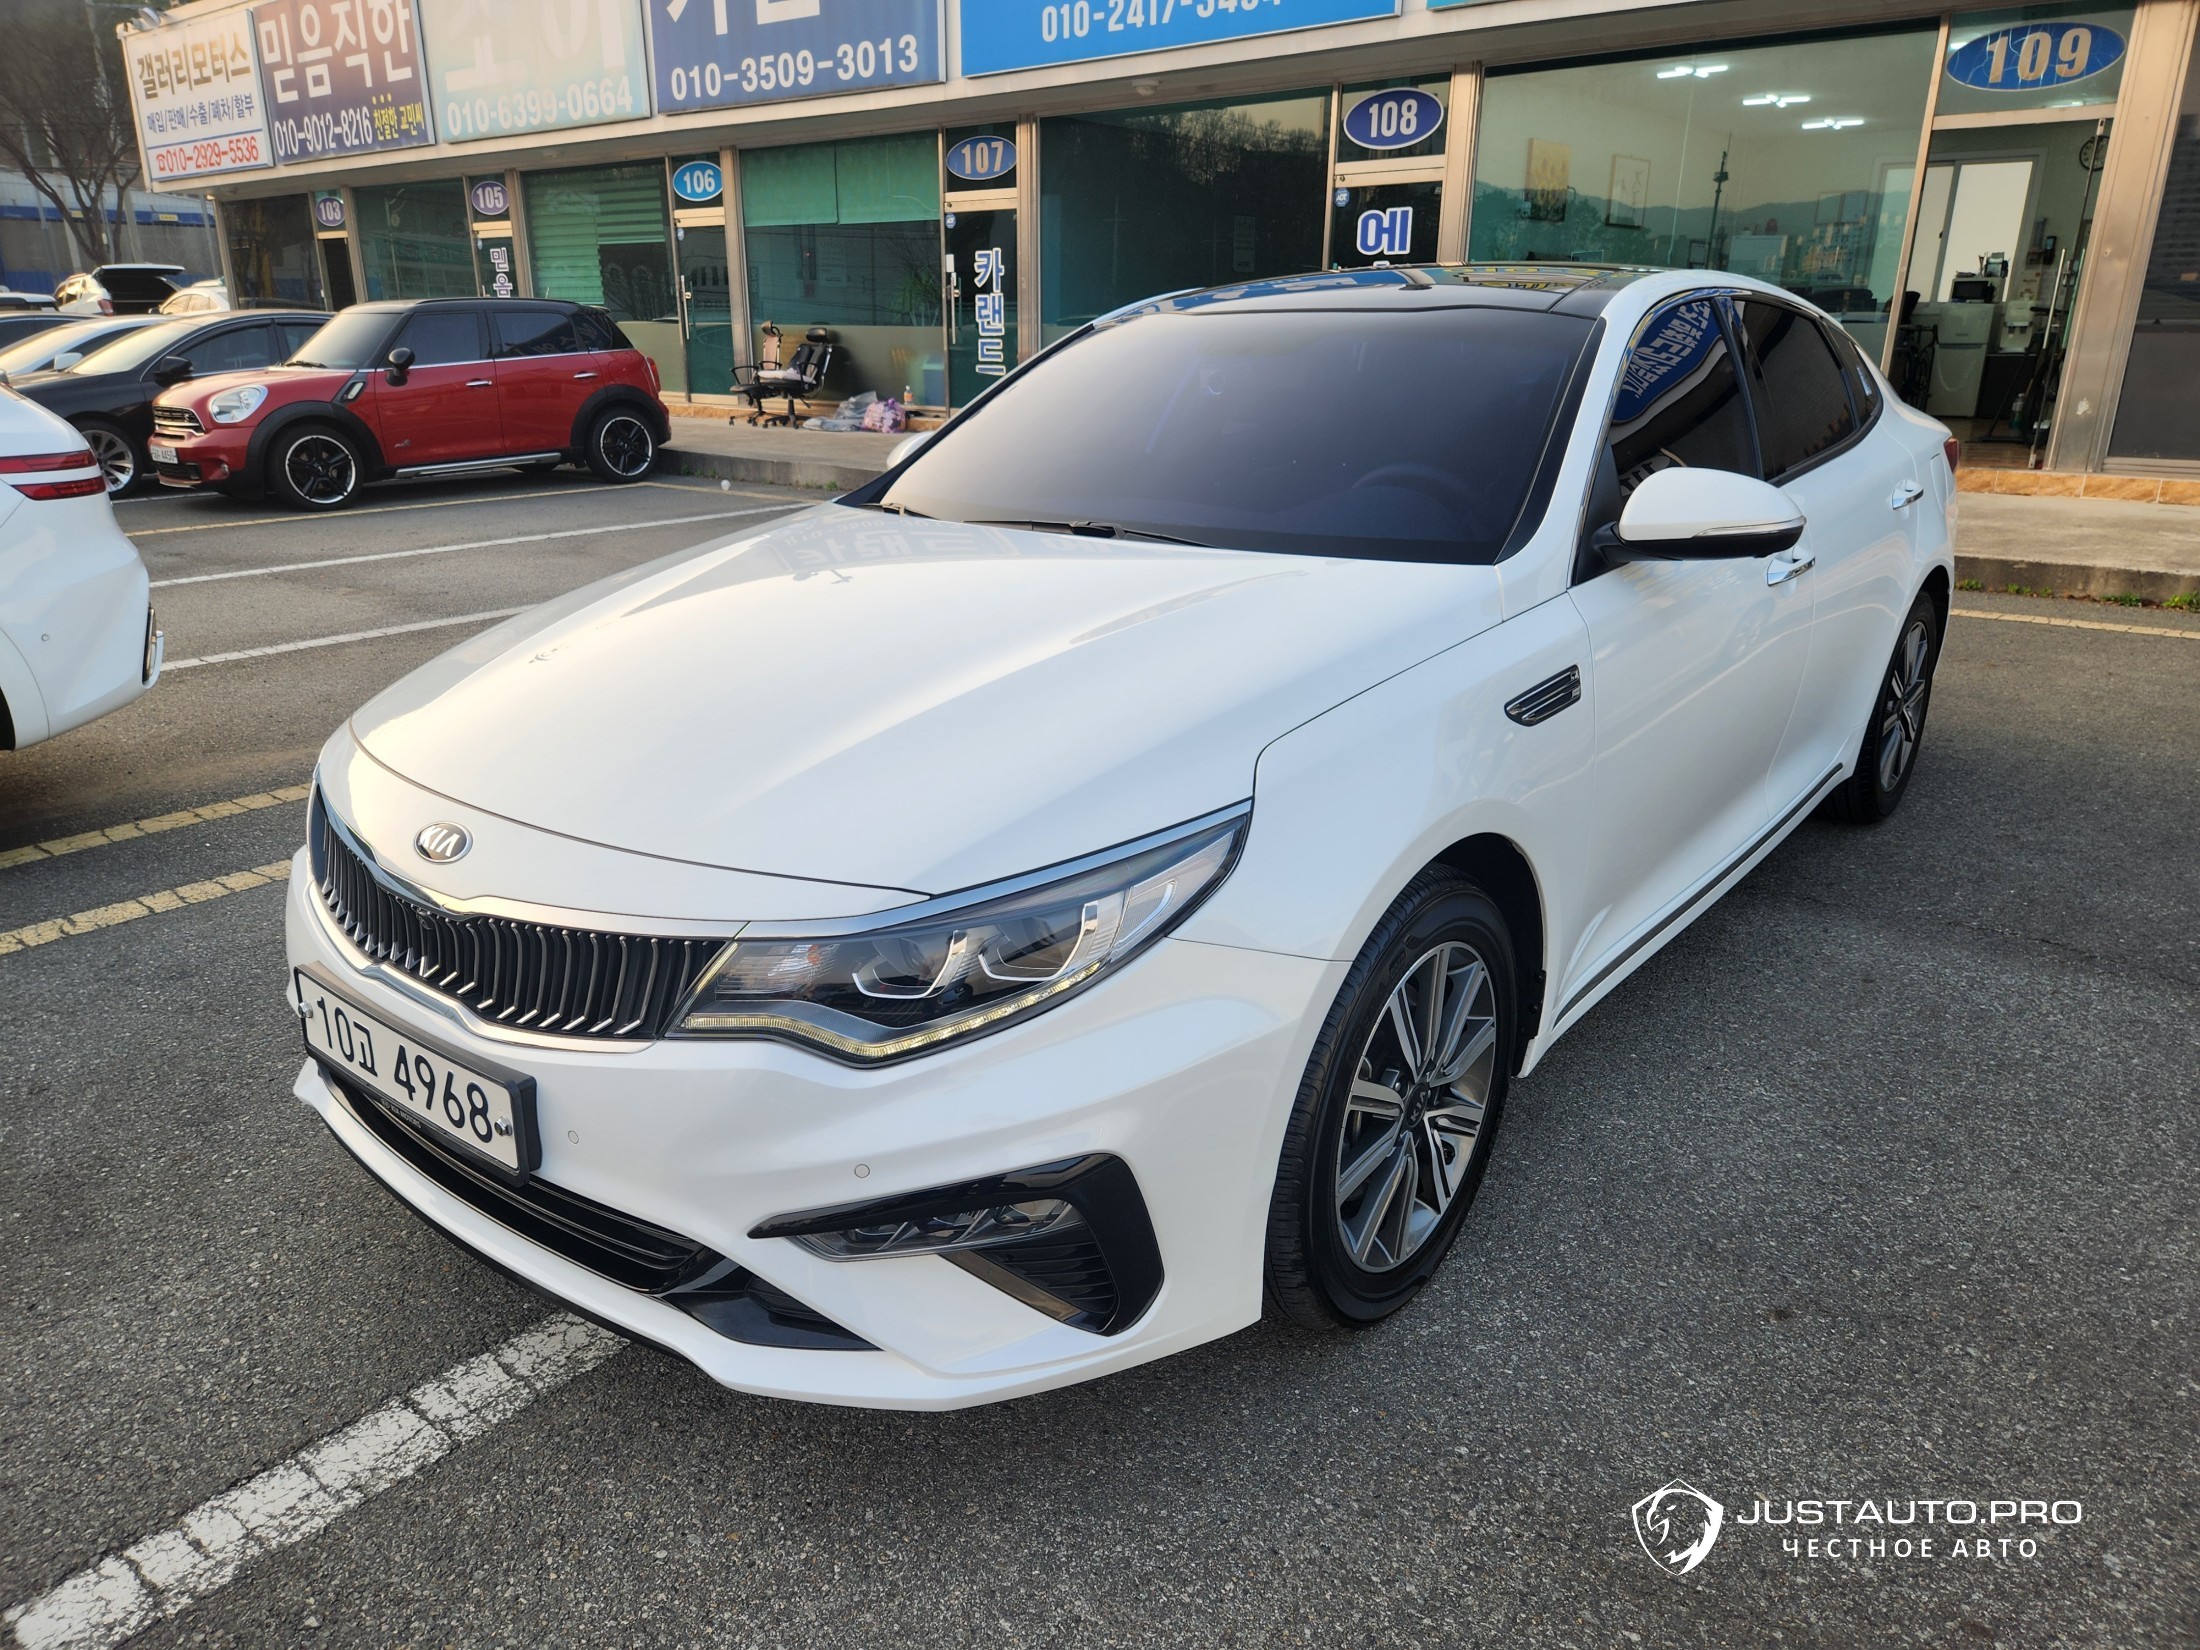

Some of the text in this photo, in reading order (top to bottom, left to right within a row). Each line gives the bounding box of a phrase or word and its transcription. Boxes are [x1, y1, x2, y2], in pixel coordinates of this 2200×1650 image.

[137, 32, 251, 100] 갤러리모터스
[259, 0, 413, 104] 믿음직한
[671, 34, 919, 100] 010-3509-3013
[1986, 27, 2092, 84] 109
[274, 105, 373, 157] 010-9012-8216
[447, 75, 633, 136] 010-6399-0664
[1369, 98, 1418, 138] 108
[166, 135, 260, 173] 010-2929-5536
[961, 140, 1004, 174] 107
[476, 186, 504, 209] 105
[683, 169, 716, 194] 106
[319, 202, 341, 221] 103
[1357, 206, 1413, 267] 에
[973, 247, 1007, 375] 카랜드
[417, 825, 461, 858] KIA
[316, 995, 493, 1143] 10고 4968
[1410, 1091, 1426, 1122] KIA
